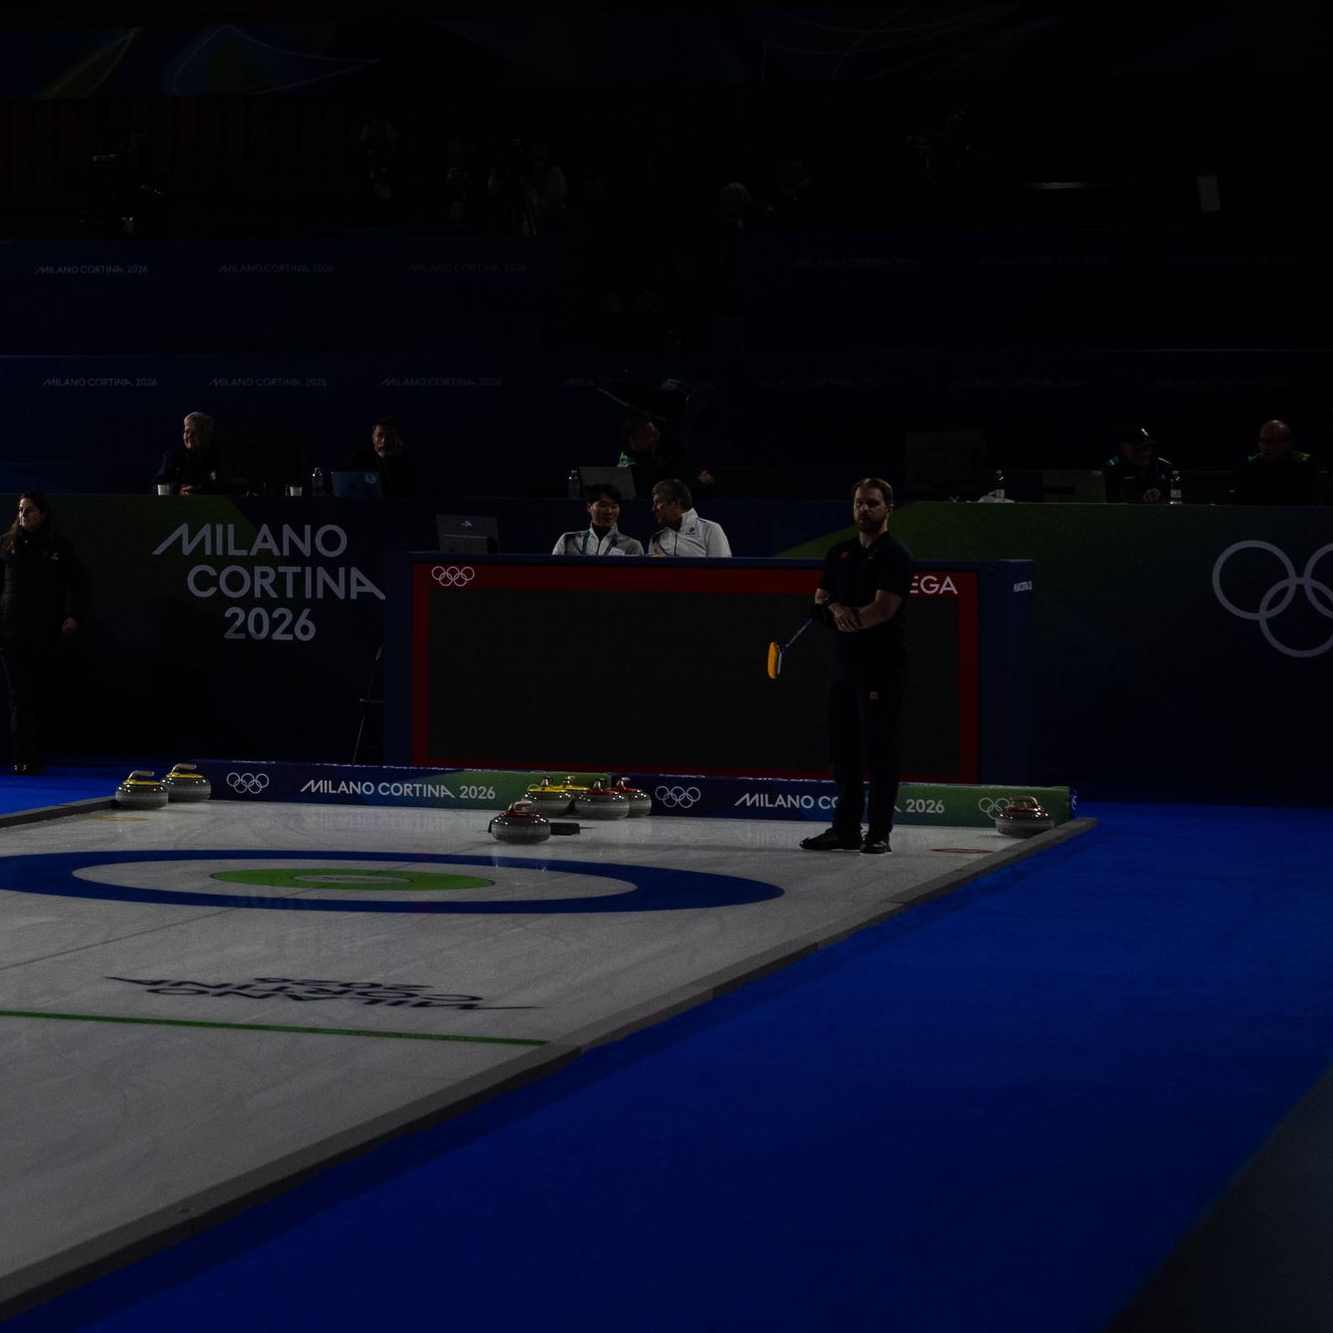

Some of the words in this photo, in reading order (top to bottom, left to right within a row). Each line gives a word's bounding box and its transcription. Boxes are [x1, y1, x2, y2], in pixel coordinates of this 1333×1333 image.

[35, 266, 79, 274] MILANO
[80, 265, 126, 273] CORTINA
[41, 378, 86, 386] MILANO
[87, 378, 134, 386] CORTINA
[151, 523, 348, 558] MILANO
[187, 564, 386, 600] CORTINA
[909, 575, 959, 594] EGA
[223, 606, 316, 642] 2026
[300, 779, 373, 795] MILANO
[379, 782, 455, 799] CORTINA
[460, 785, 496, 799] 2026
[734, 793, 814, 809] MILANO
[906, 798, 945, 814] 2026
[105, 976, 483, 1002] CORTINA
[253, 977, 434, 991] 2026
[147, 988, 542, 1010] MILANO
